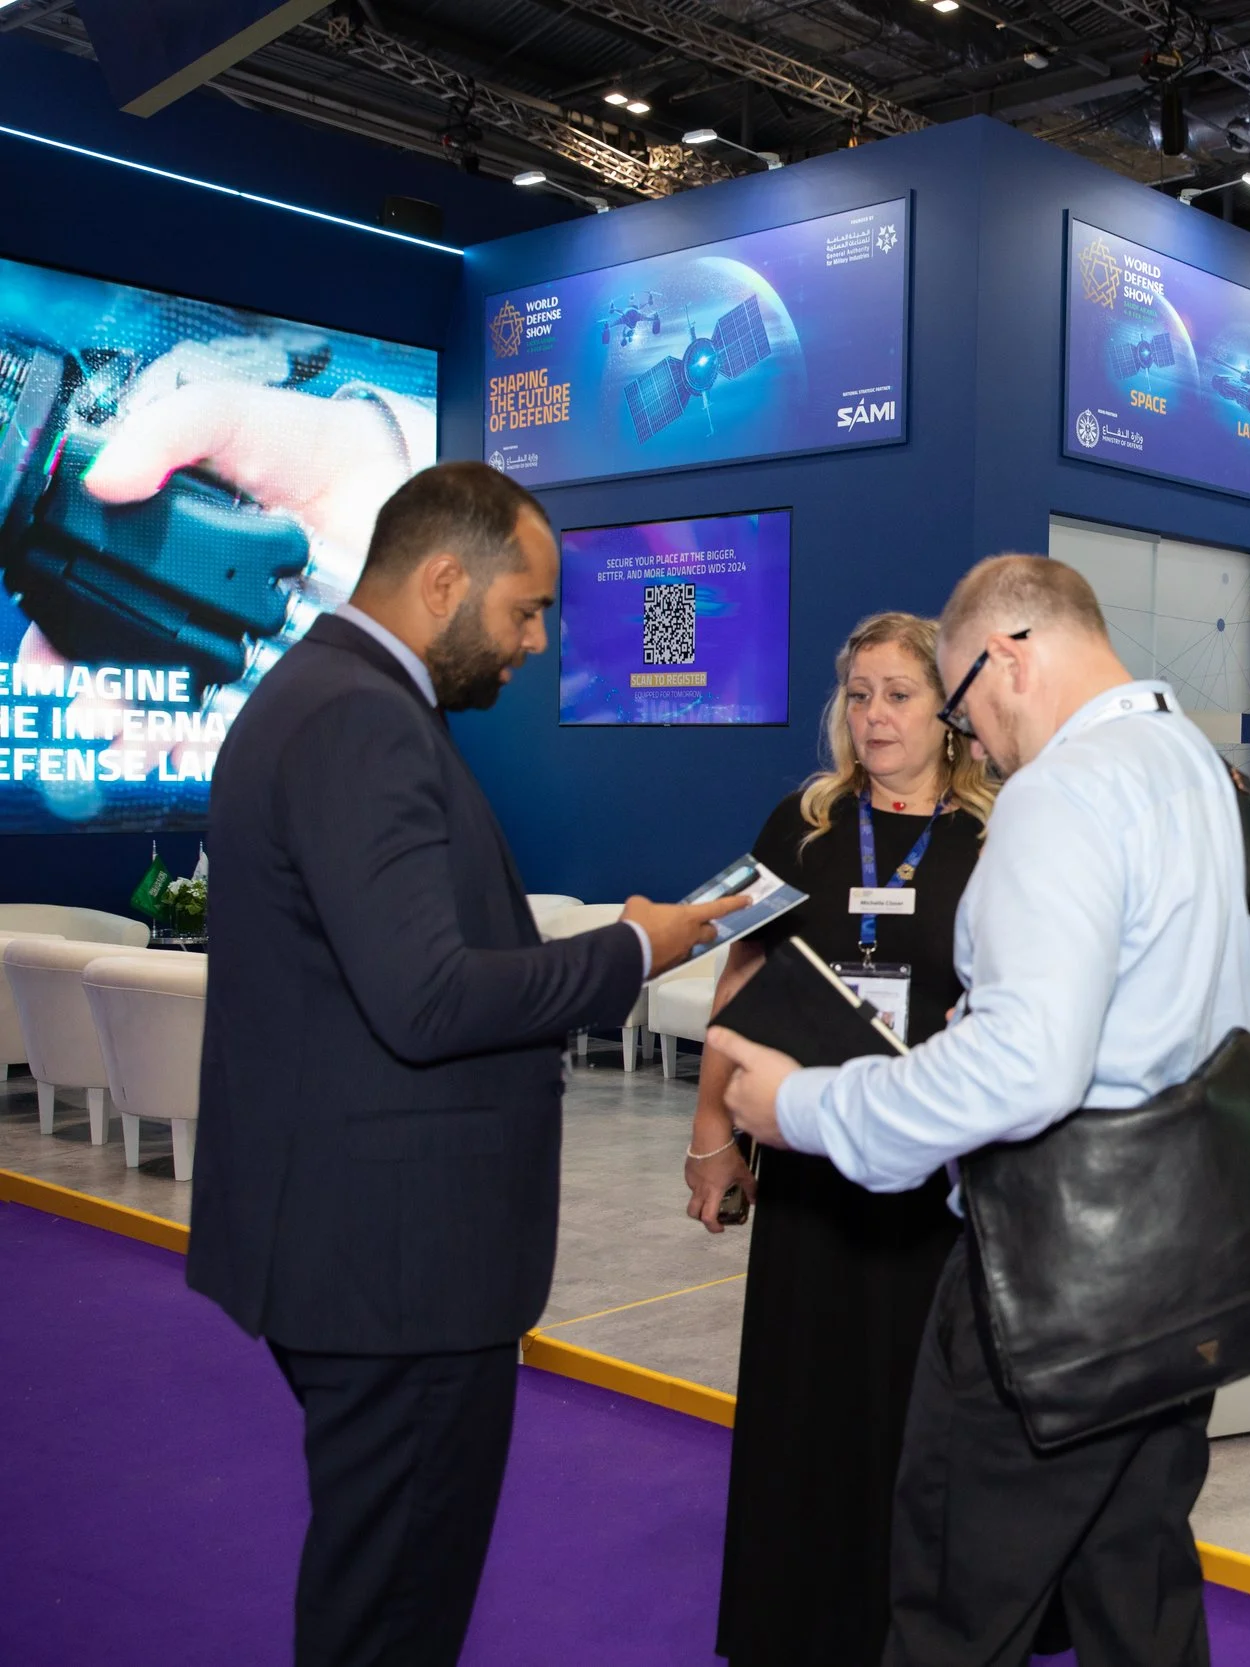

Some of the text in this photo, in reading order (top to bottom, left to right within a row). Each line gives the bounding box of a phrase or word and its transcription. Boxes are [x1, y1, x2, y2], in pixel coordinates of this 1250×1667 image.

[826, 246, 869, 259] General Authority
[1124, 254, 1161, 278] WORLD
[1124, 270, 1164, 296] DEFENSE
[526, 297, 558, 312] WORLD
[1124, 286, 1153, 306] SHOW
[526, 309, 561, 325] DEFENSE
[526, 324, 552, 338] SHOW
[490, 368, 548, 396] SHAPING
[490, 383, 570, 414] THE FUTURE
[1130, 390, 1167, 415] SPACE
[490, 402, 570, 432] OF DEFENSE
[1102, 436, 1120, 445] MINISTRY
[1127, 441, 1143, 451] DEFENSE
[607, 549, 736, 569] SECURE YOUR PLACE AT THE BIGGER,
[598, 562, 747, 582] BETTER, AND MORE ADVANCED WDS 2024
[631, 673, 706, 686] SCAN TO REGISTER
[635, 691, 659, 699] EQUIPPED
[671, 690, 701, 698] TOMORROW
